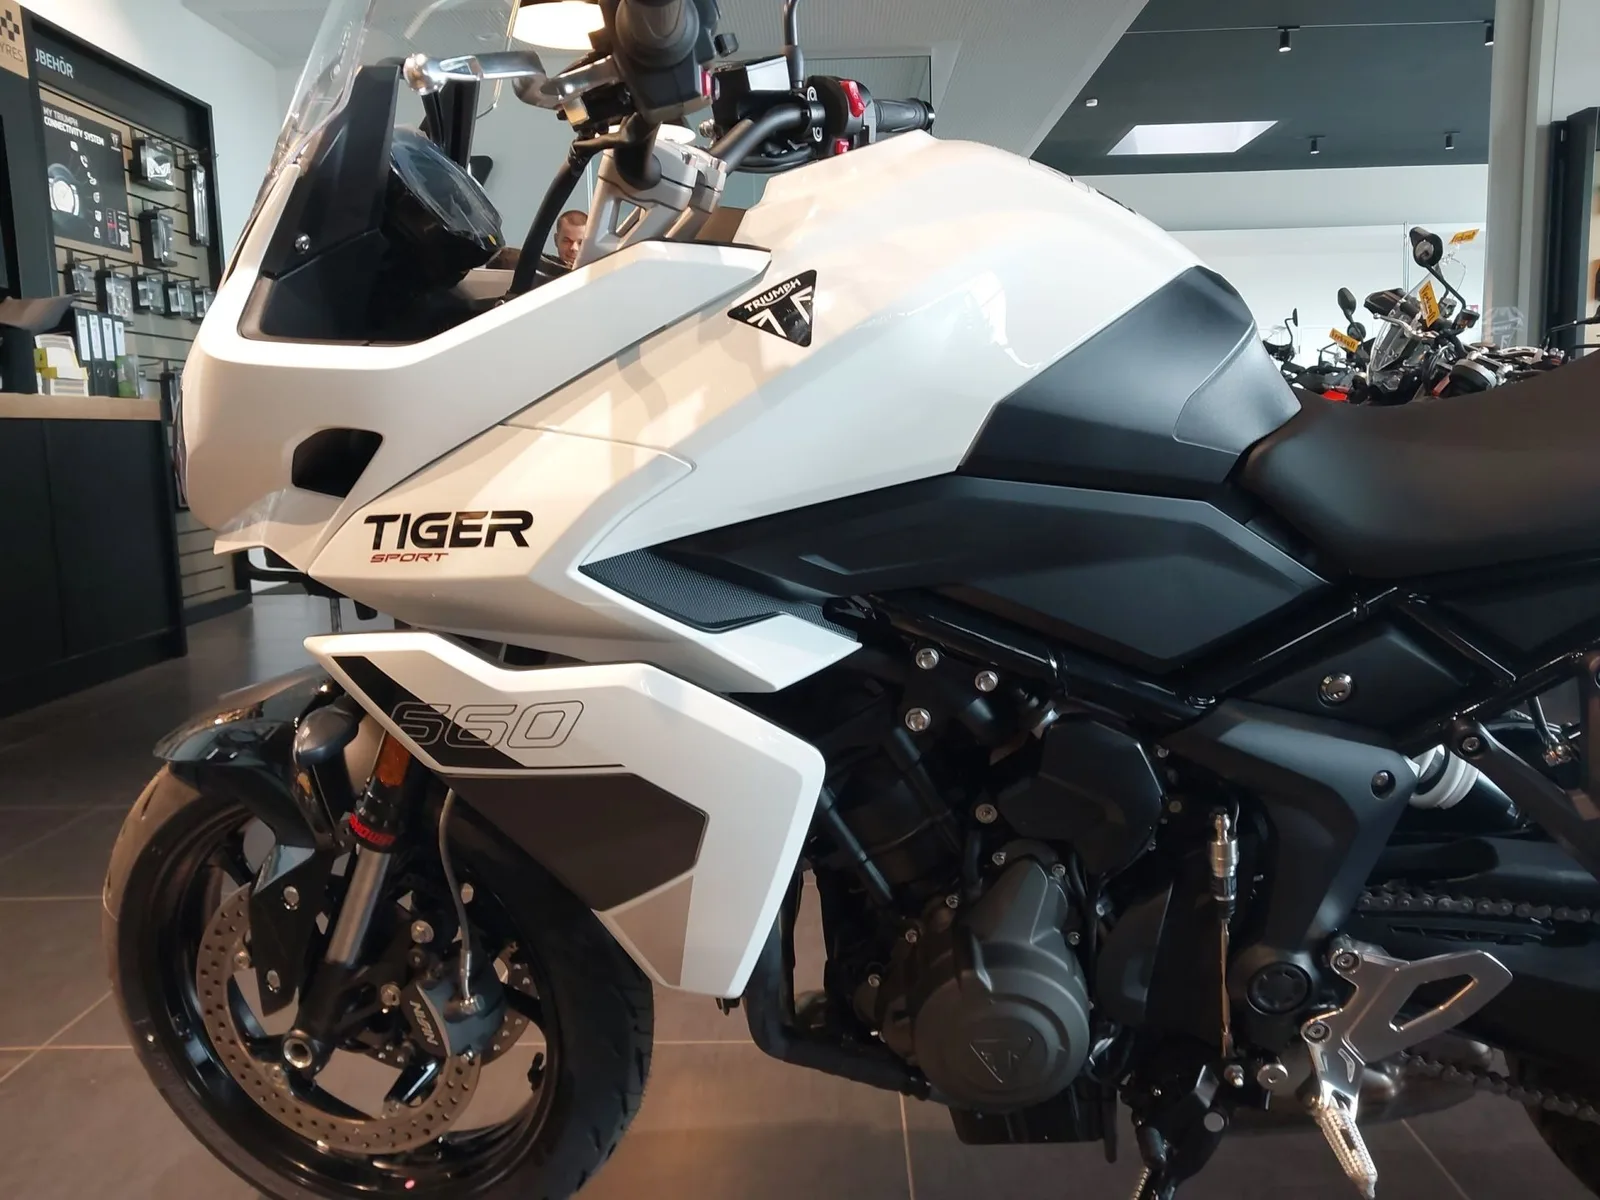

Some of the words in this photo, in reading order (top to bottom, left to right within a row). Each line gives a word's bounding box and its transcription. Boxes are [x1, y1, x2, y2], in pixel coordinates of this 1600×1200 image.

[44, 116, 83, 138] CONNECTIVITY
[83, 131, 105, 146] SYSTEM
[744, 278, 801, 312] TRIUMPH
[364, 510, 534, 551] TIGER
[370, 552, 449, 563] SPORT
[391, 700, 585, 749] 660
